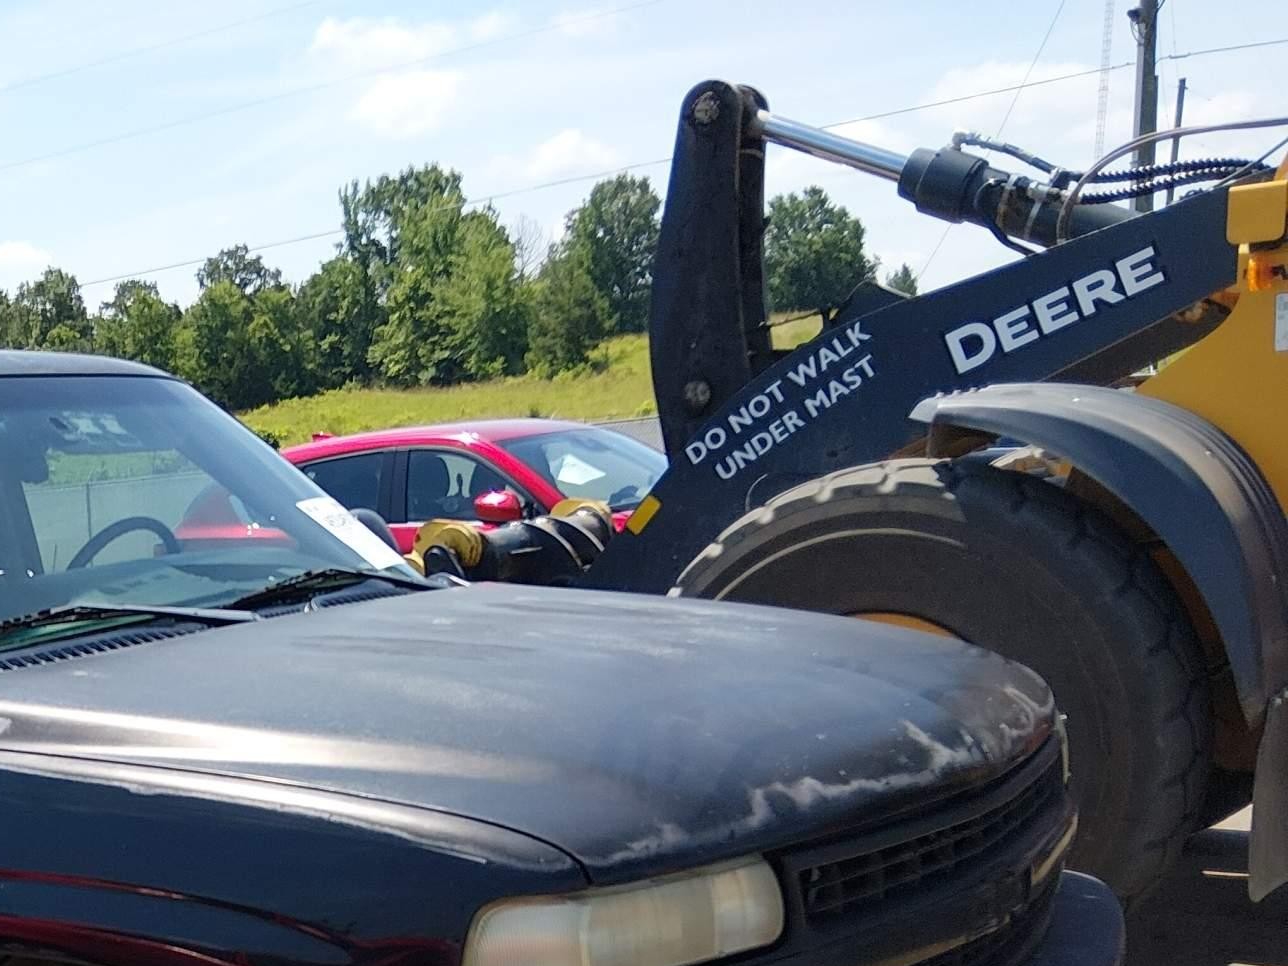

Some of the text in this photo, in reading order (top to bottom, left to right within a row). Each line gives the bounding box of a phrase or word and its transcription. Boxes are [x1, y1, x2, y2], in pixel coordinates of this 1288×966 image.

[944, 245, 1166, 374] DEERE
[685, 321, 872, 465] DO NOT WALK
[714, 353, 876, 480] UNDER MAST
